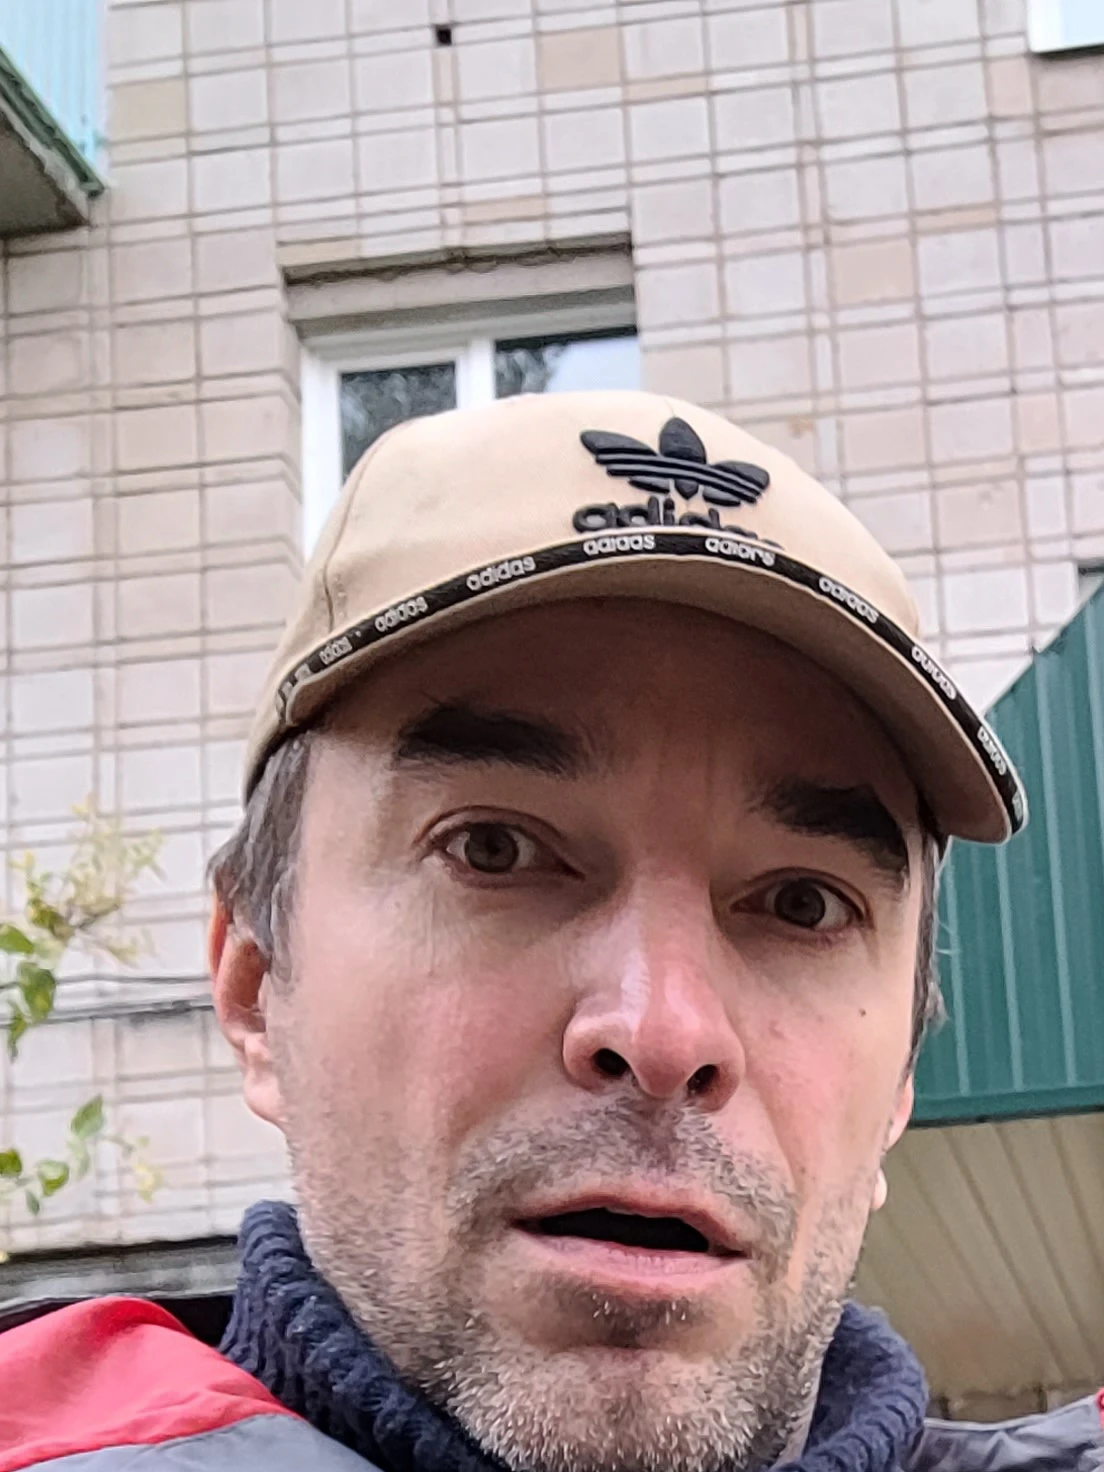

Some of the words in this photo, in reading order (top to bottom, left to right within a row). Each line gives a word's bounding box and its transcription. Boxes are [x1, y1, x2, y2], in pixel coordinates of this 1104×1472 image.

[466, 557, 536, 591] adidas
[583, 535, 656, 556] adidas
[819, 577, 879, 623] adidas
